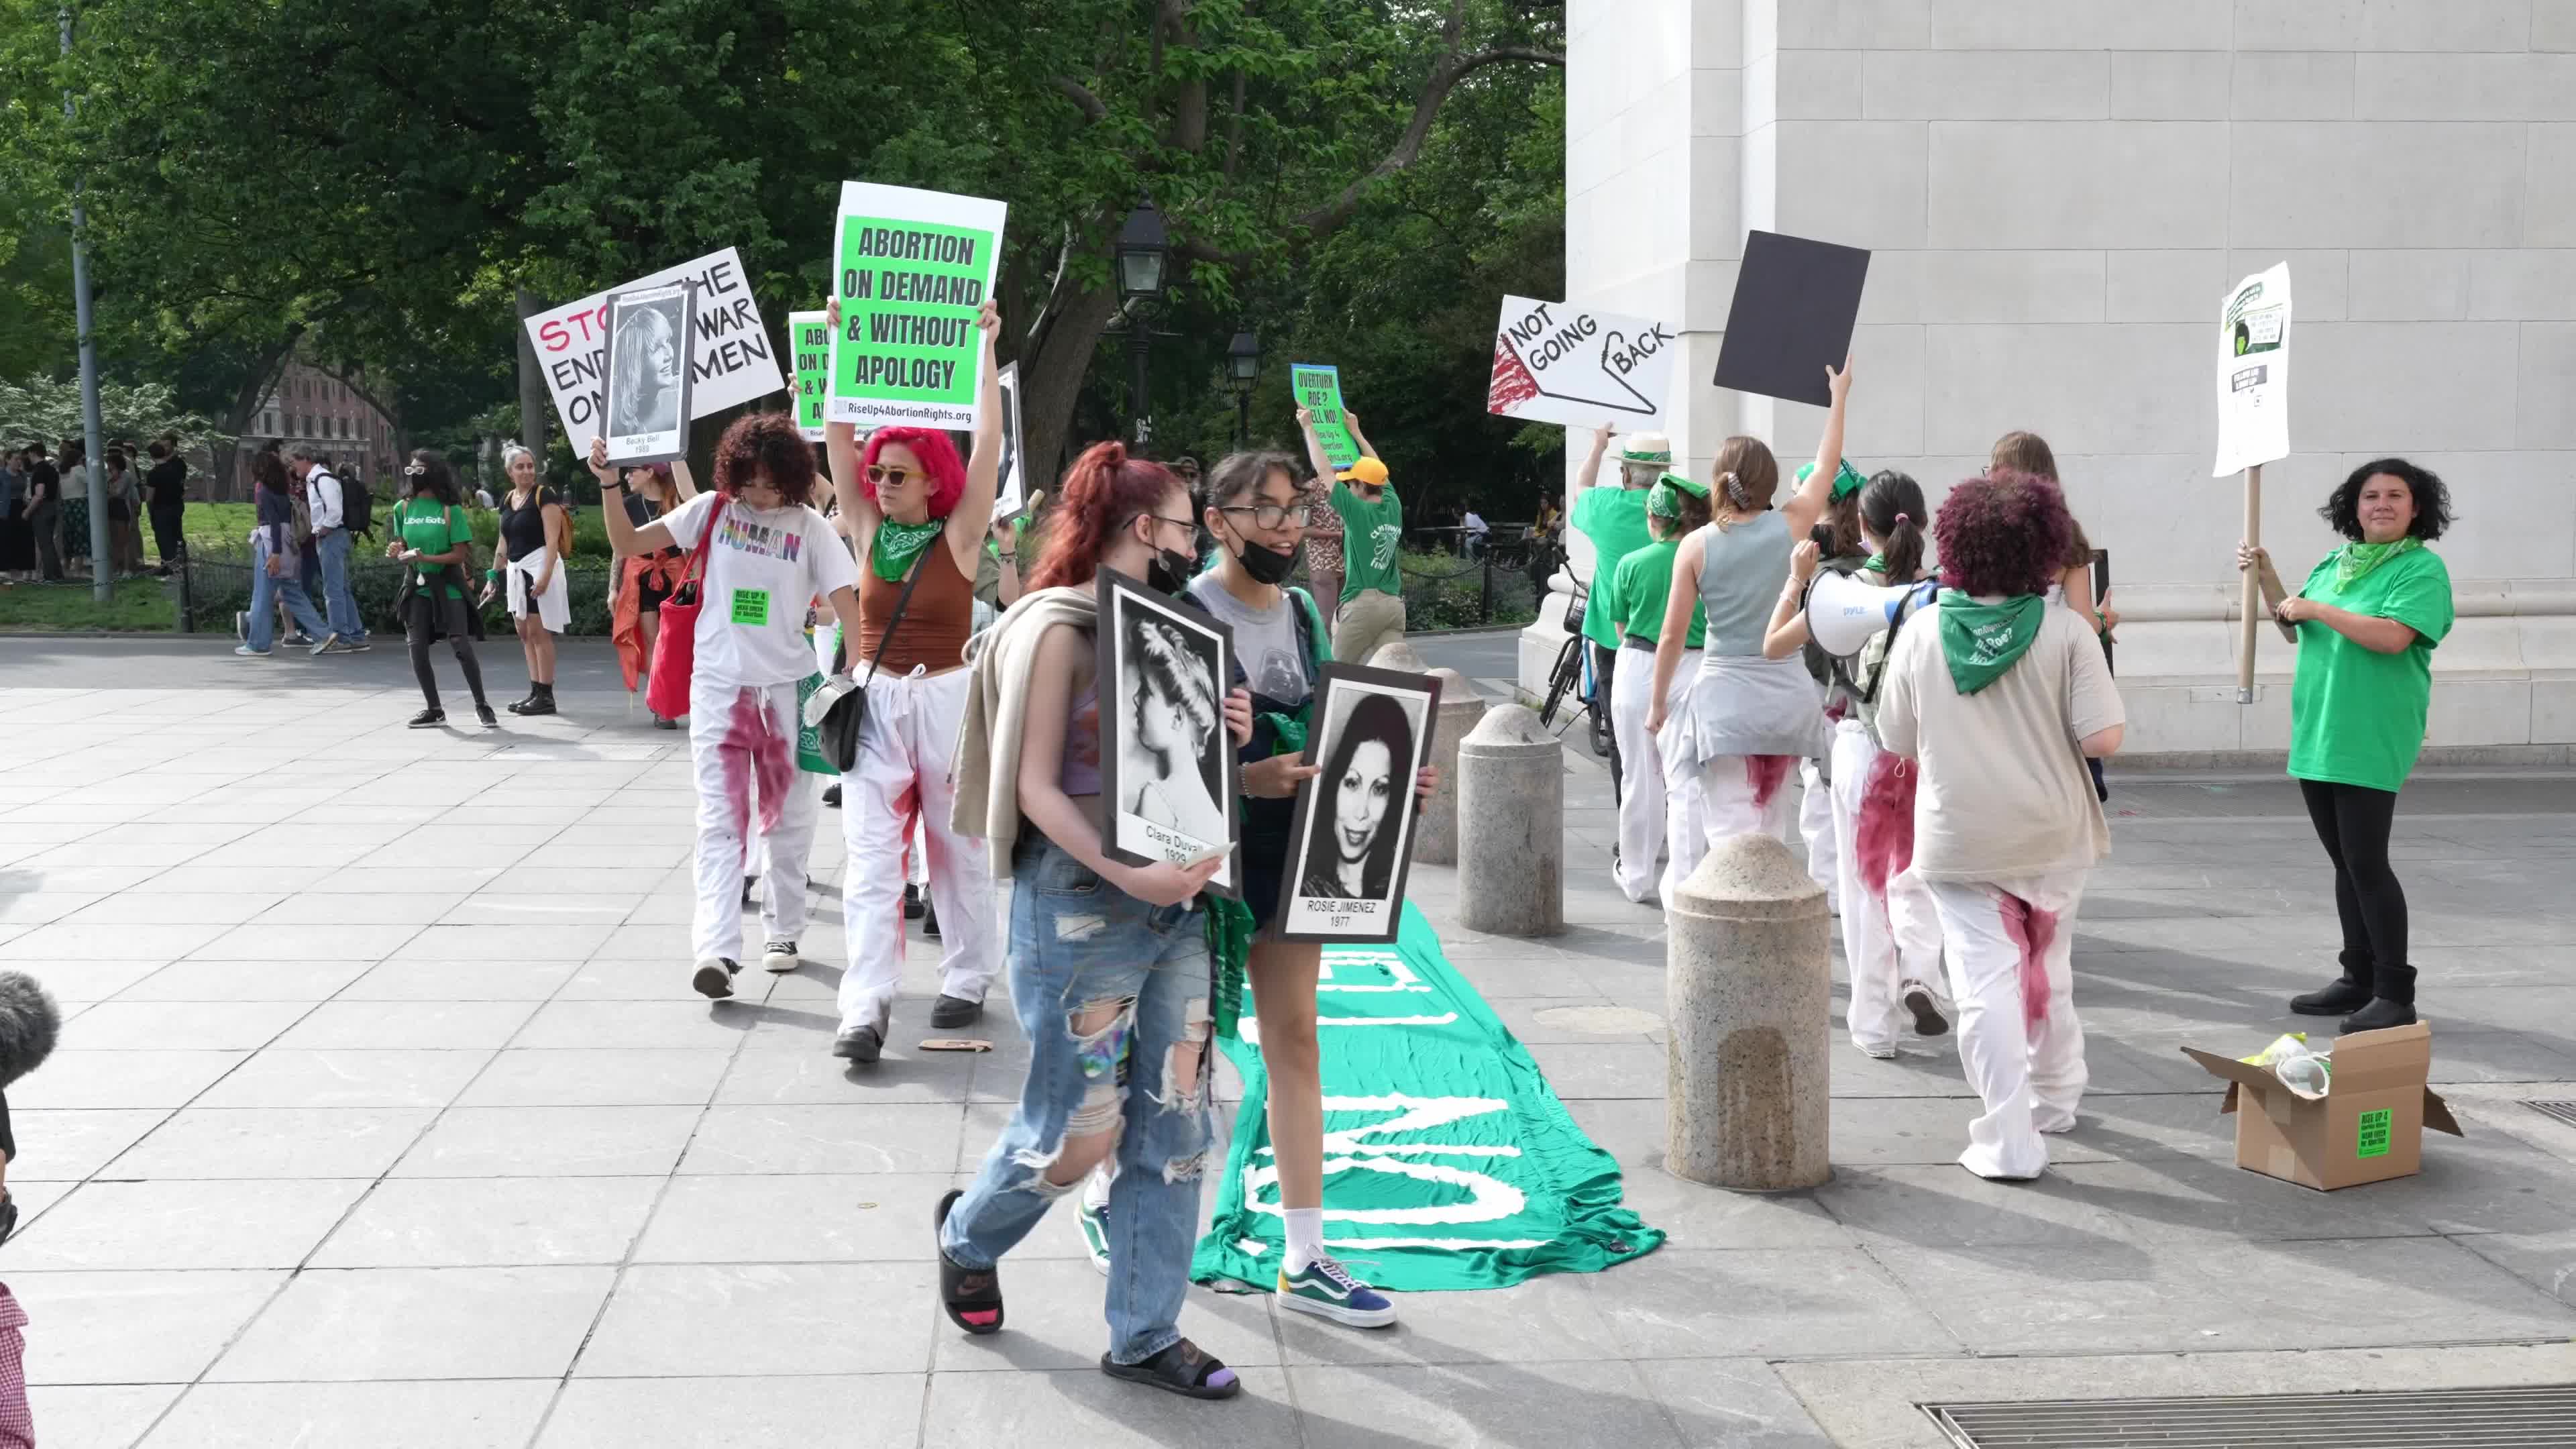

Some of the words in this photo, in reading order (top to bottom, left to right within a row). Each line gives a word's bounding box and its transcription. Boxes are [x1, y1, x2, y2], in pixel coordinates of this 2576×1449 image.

[858, 227, 974, 266] ABORTION
[844, 269, 873, 299] ON
[880, 271, 982, 307] DEMAND
[695, 299, 759, 341] WAR
[847, 315, 861, 341] &
[870, 313, 971, 348] WITHOUT
[1508, 303, 1554, 347] NOT
[692, 333, 769, 384] MEN
[1529, 315, 1597, 370] GOING
[1611, 322, 1675, 375] BACK
[799, 354, 816, 370] ON
[855, 355, 955, 390] APOLOGY
[805, 380, 813, 394] &
[1299, 373, 1334, 388] OVERTURN
[848, 402, 972, 424] RiseUp4AbortionRights.org
[718, 516, 801, 562] HUMAN
[1146, 826, 1171, 845] Clara
[1307, 900, 1336, 912] ROSIE
[1338, 901, 1376, 913] JIMENEZ
[1331, 916, 1350, 927] 1977
